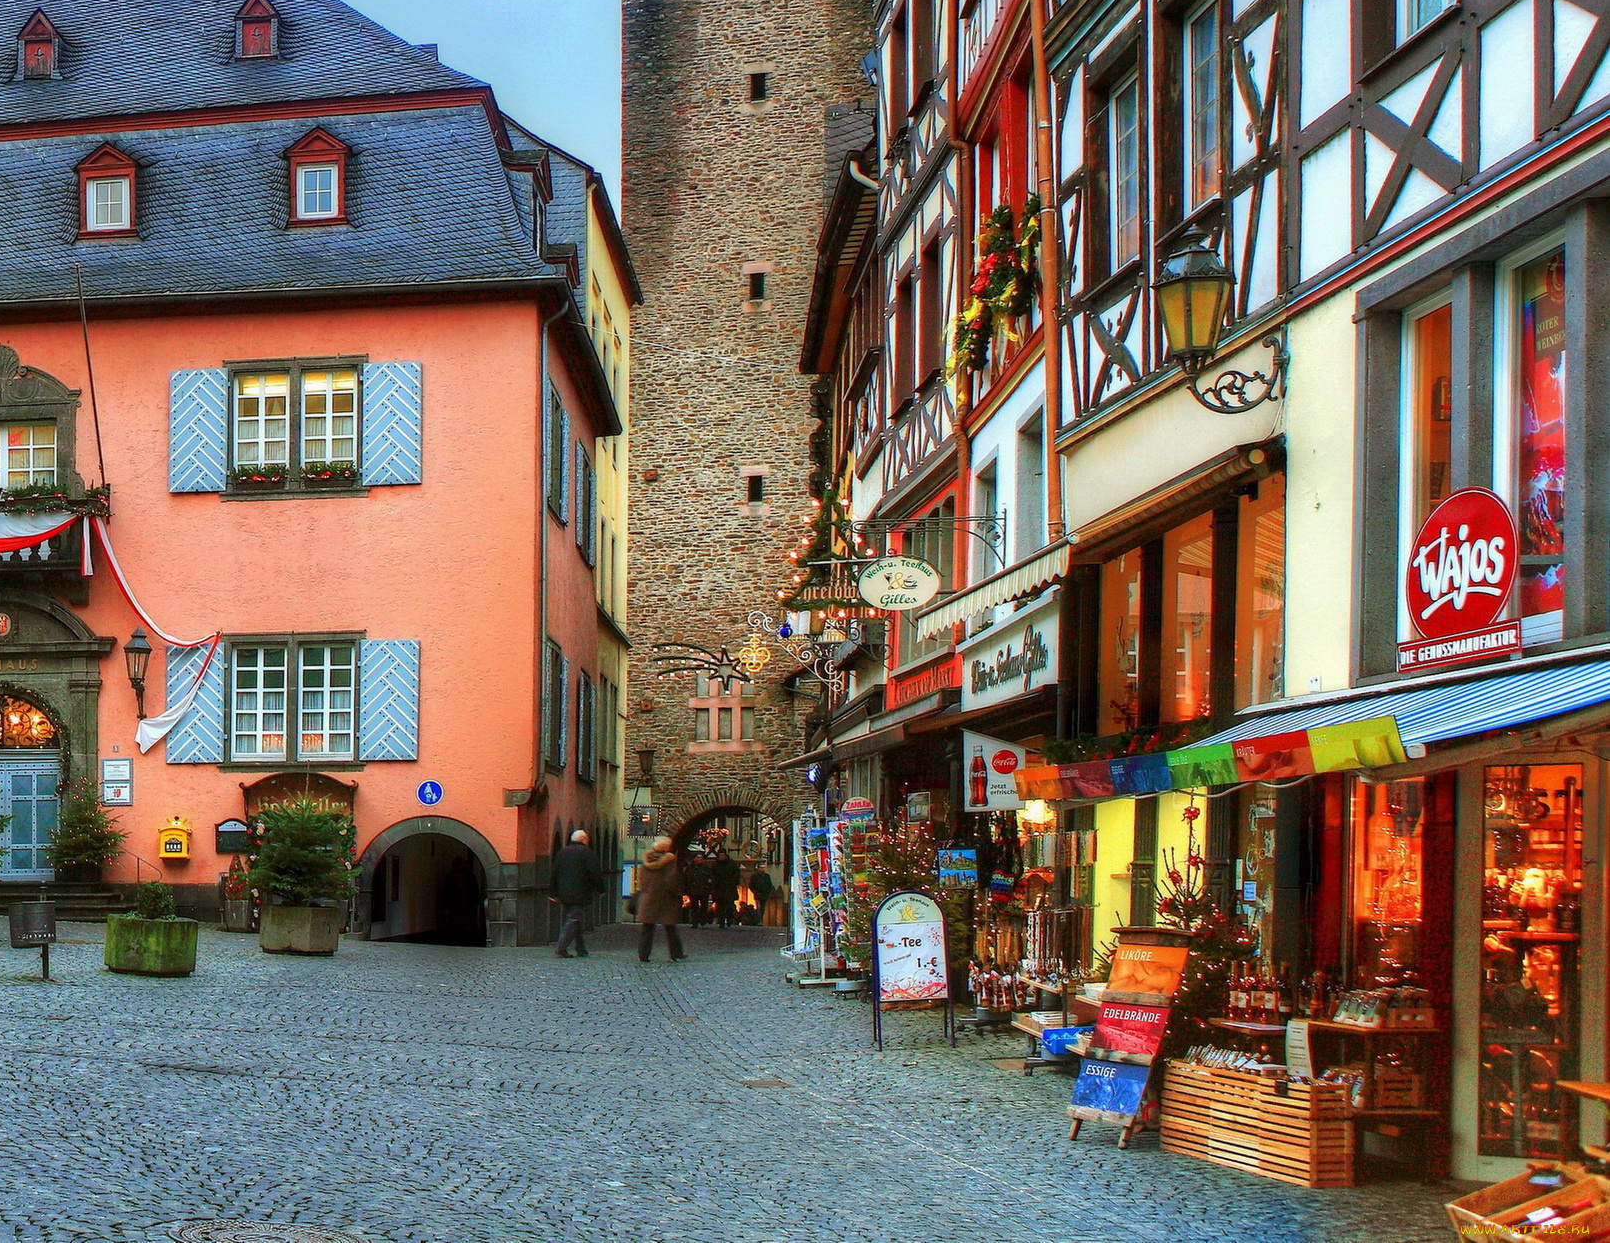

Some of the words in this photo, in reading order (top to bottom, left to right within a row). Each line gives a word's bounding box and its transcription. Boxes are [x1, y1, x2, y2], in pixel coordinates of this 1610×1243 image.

[880, 593, 917, 607] Gilles
[1399, 648, 1416, 665] DIE
[1417, 628, 1517, 662] GENUSSMANUFAKTUR
[1120, 948, 1153, 962] LIKÖRE
[1103, 1007, 1162, 1024] EDELBRÄNDE
[1086, 1064, 1117, 1078] ESSIGE
